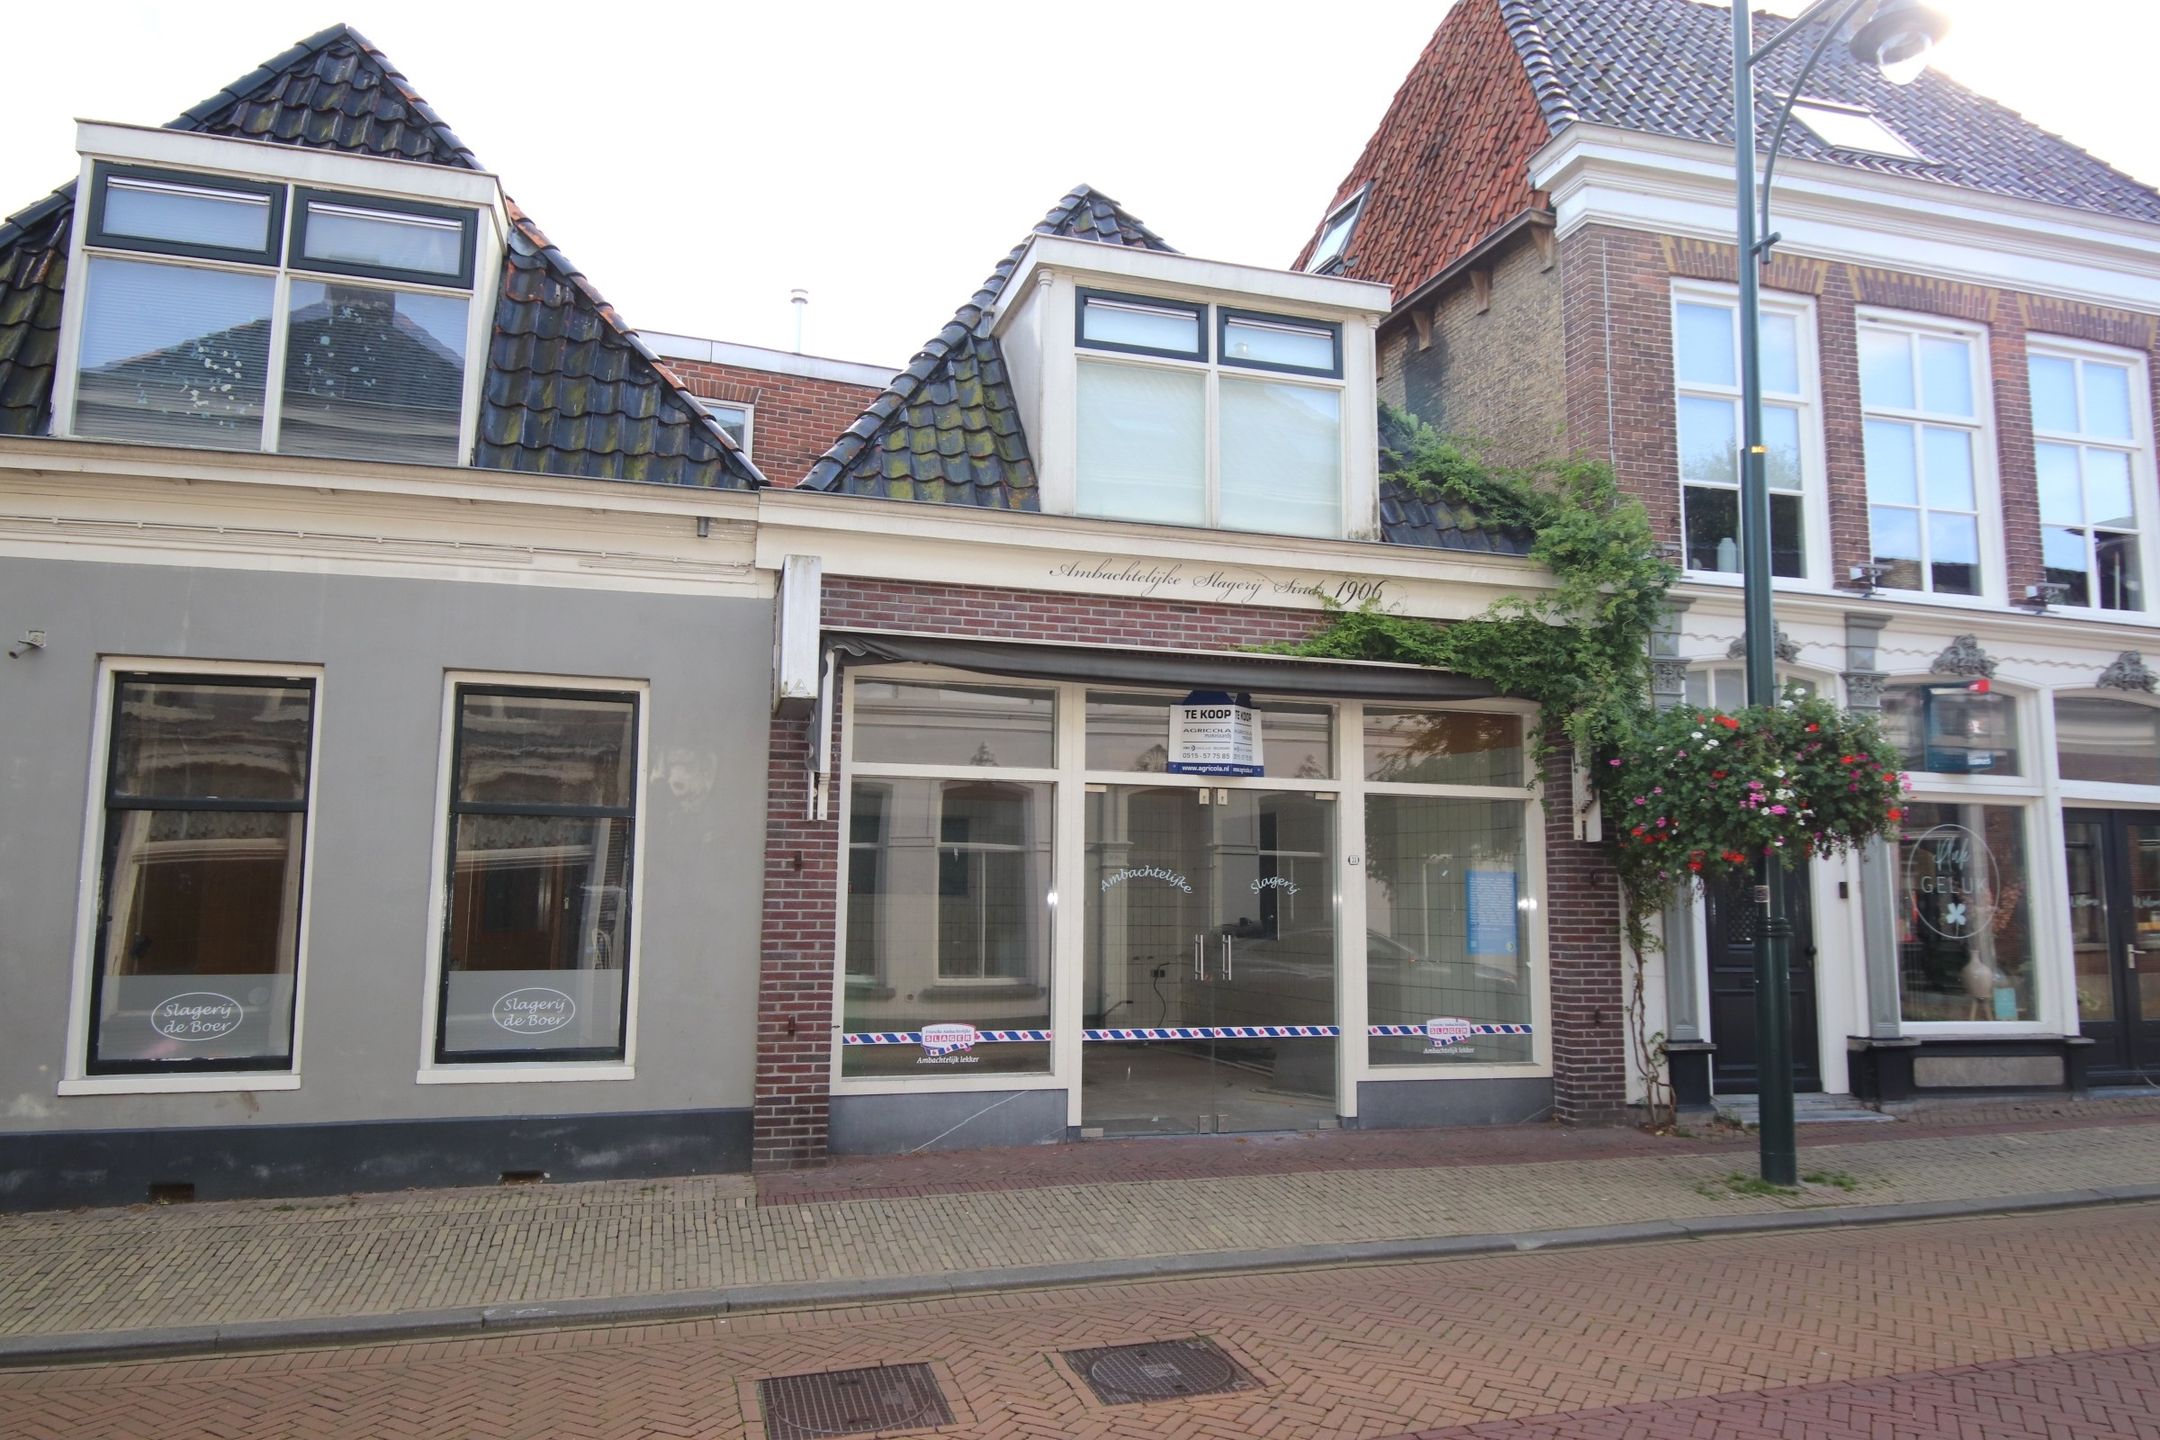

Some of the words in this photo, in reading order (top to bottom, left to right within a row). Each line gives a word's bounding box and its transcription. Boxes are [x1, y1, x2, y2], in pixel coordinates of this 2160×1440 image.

[1334, 579, 1392, 605] 1906
[1184, 709, 1198, 719] TE
[1200, 709, 1231, 719] KOOP
[1100, 864, 1192, 894] Ambachtelijke
[1250, 875, 1300, 895] Slagerij
[163, 1003, 233, 1020] Slagerij
[503, 998, 567, 1014] Slagerij
[164, 1020, 188, 1033] de
[190, 1020, 232, 1033] Boer
[503, 1014, 526, 1026] de
[527, 1014, 565, 1026] Boer
[916, 1056, 960, 1064] Ambachtelijk
